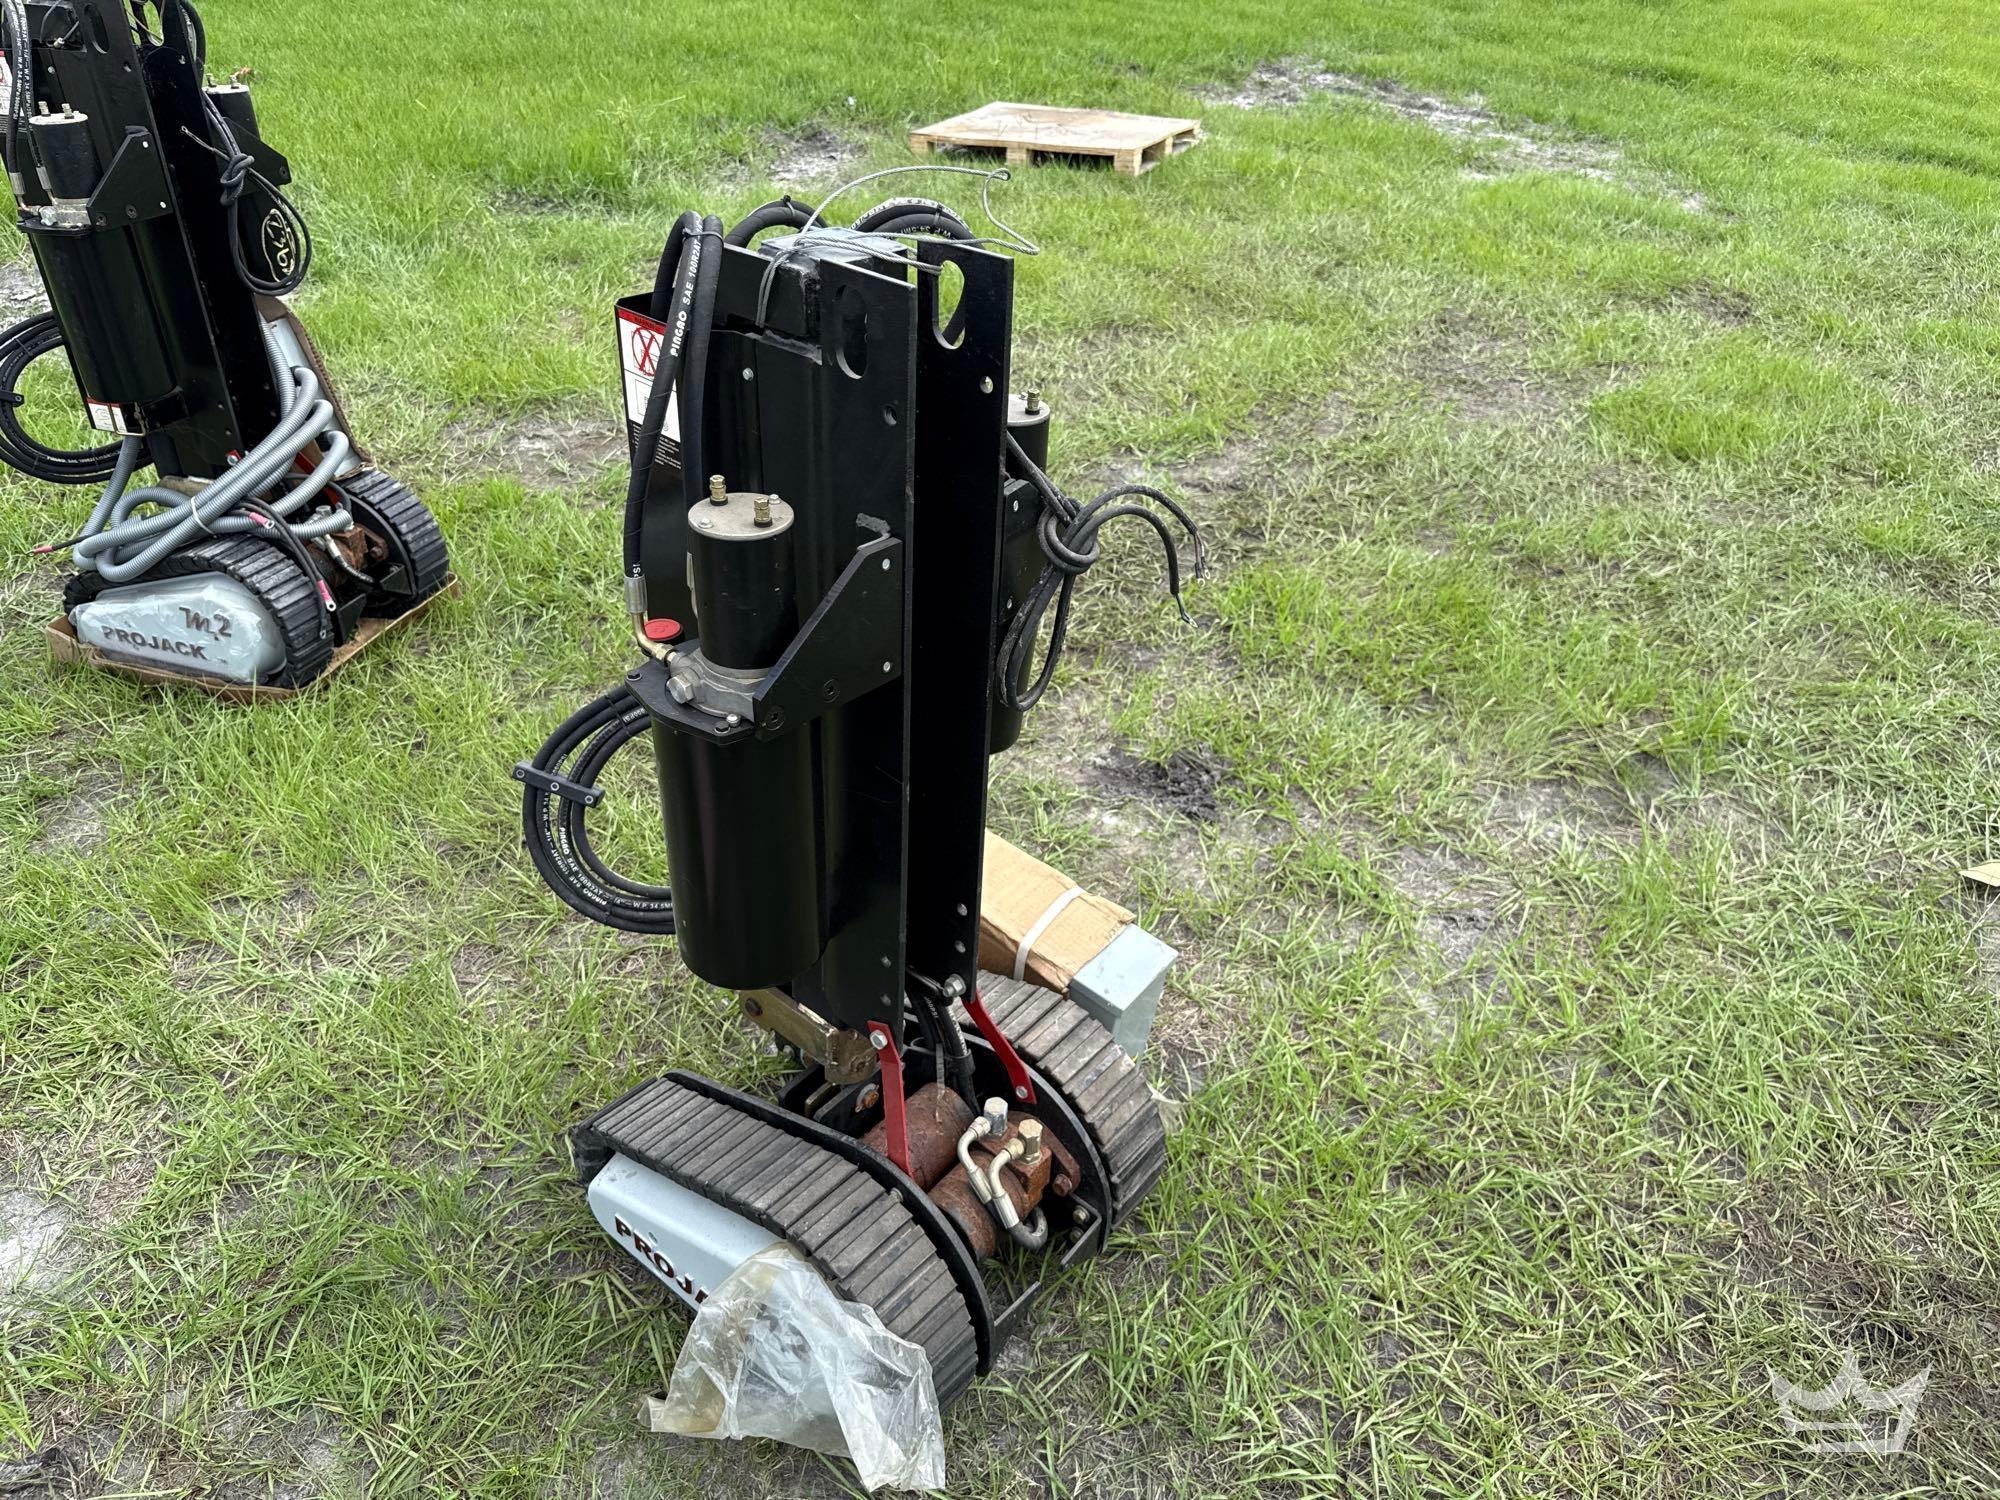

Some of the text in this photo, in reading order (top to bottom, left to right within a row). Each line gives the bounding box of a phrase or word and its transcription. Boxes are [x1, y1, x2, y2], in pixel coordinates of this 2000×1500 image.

[688, 240, 702, 278] 100R2AT
[682, 282, 695, 305] SAE
[670, 310, 687, 357] PINGAO
[101, 625, 208, 661] PROJACK
